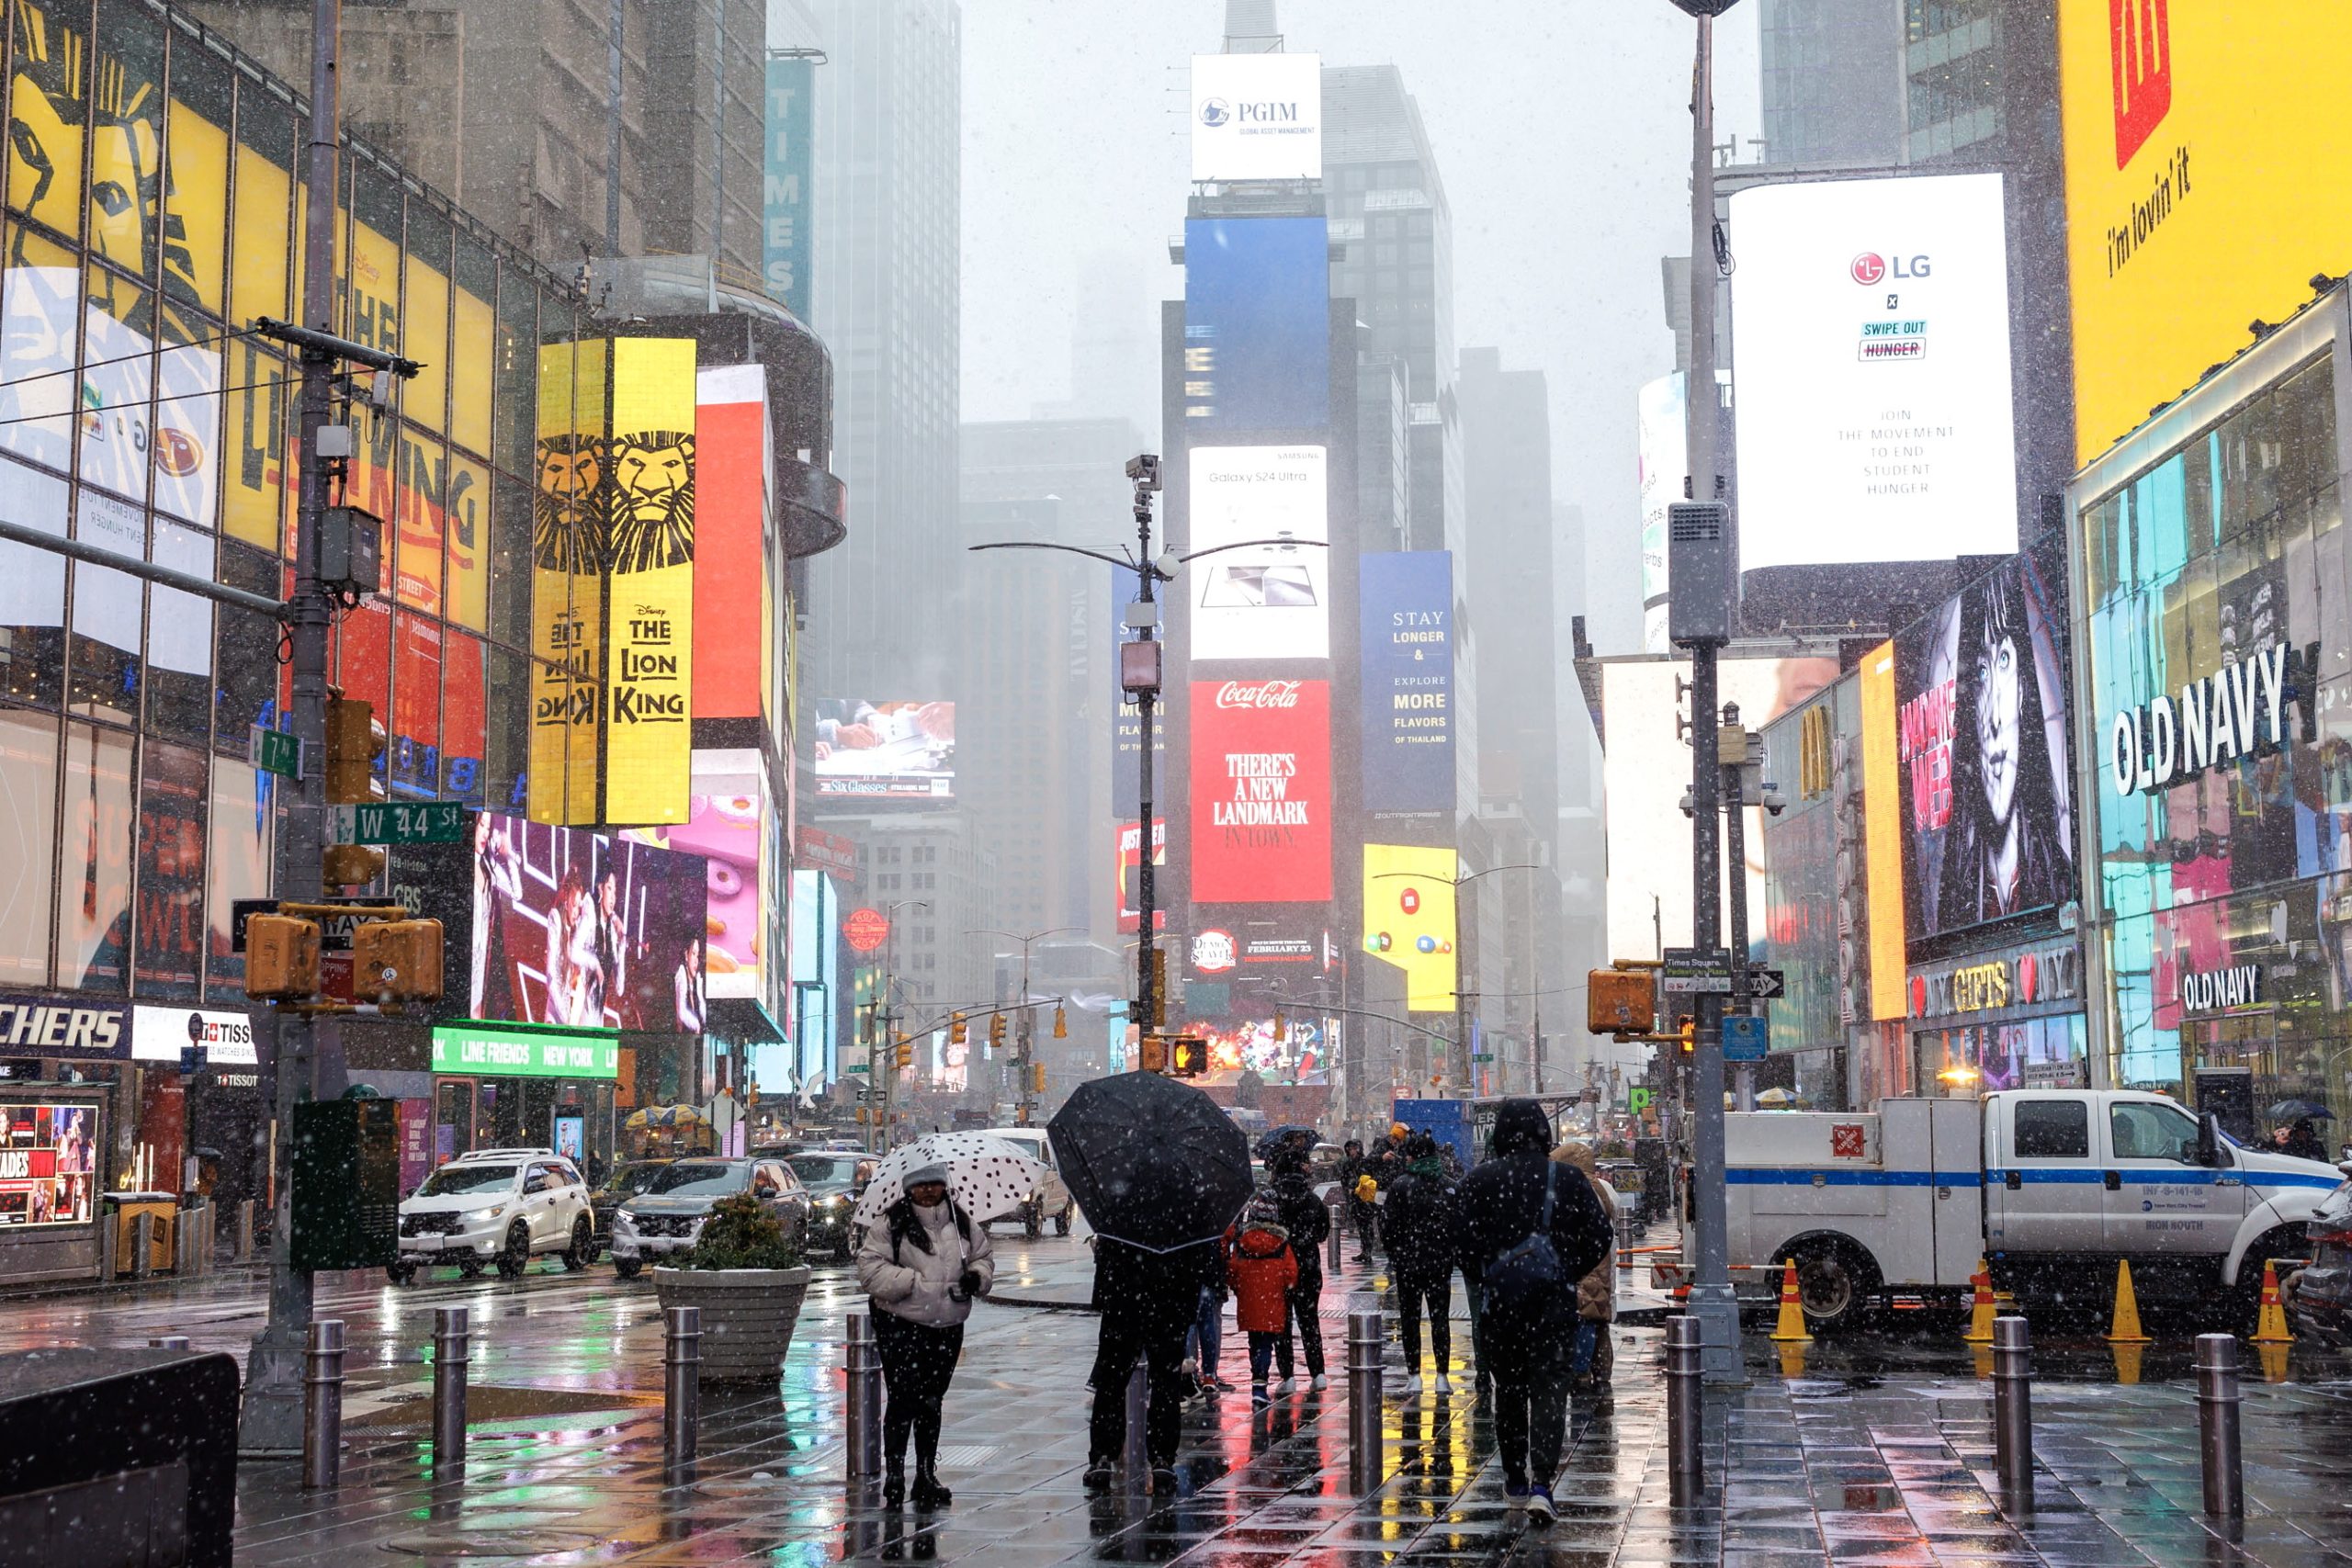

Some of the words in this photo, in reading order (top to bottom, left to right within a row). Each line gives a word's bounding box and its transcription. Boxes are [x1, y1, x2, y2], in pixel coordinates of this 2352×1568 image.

[1238, 102, 1297, 121] PGIM
[764, 88, 798, 290] TIMES
[2108, 225, 2130, 278] i'm
[2132, 158, 2173, 251] lovin'
[2177, 146, 2191, 200] it
[1893, 254, 1930, 278] LG
[1864, 323, 1899, 335] SWIPE
[1904, 321, 1926, 333] OUT
[1866, 342, 1918, 357] HUNGER
[1881, 410, 1911, 420] JOIN
[1838, 430, 1863, 440] THE
[1871, 426, 1953, 439] MOVEMENT
[1871, 446, 1888, 457] TO
[1894, 446, 1924, 457] END
[1209, 472, 1253, 483] Galaxy
[1255, 472, 1275, 481] S24
[1278, 472, 1306, 481] Ultra
[1864, 464, 1929, 476] STUDENT
[1868, 482, 1928, 494] HUNGER
[634, 604, 666, 617] Disney
[1393, 611, 1444, 626] STAY
[629, 621, 671, 638] THE
[1394, 631, 1444, 643] LONGER
[1414, 649, 1424, 660] &
[621, 649, 677, 682] LION
[1395, 676, 1446, 686] EXPLORE
[1216, 680, 1302, 709] Coca-Cola
[1394, 694, 1446, 709] MORE
[614, 686, 684, 724] KING
[1395, 716, 1446, 728] FLAVORS
[1901, 678, 1957, 763] MADAME
[2112, 695, 2175, 796] OLD
[2183, 641, 2287, 774] NAVY
[1396, 736, 1406, 744] OF
[1408, 735, 1446, 743] THAILAND
[271, 737, 278, 766] 7
[1226, 753, 1295, 777] THERE'S
[1235, 778, 1246, 801] A
[1250, 778, 1288, 801] NEW
[1911, 744, 1953, 832] WEB
[1214, 801, 1308, 826] LANDMARK
[362, 809, 384, 839] W
[397, 808, 429, 838] 44
[393, 884, 422, 915] CBS
[1248, 945, 1299, 953] FEBRUARY
[1300, 944, 1312, 953] 23
[1954, 961, 2007, 1012] GIFTS
[2184, 973, 2213, 1011] OLD
[2214, 964, 2256, 1008] NAVY
[462, 1041, 486, 1063] LINE
[488, 1042, 530, 1065] FRIENDS
[543, 1045, 566, 1066] NEW
[568, 1047, 594, 1067] YORK
[230, 1075, 258, 1087] TISSOT
